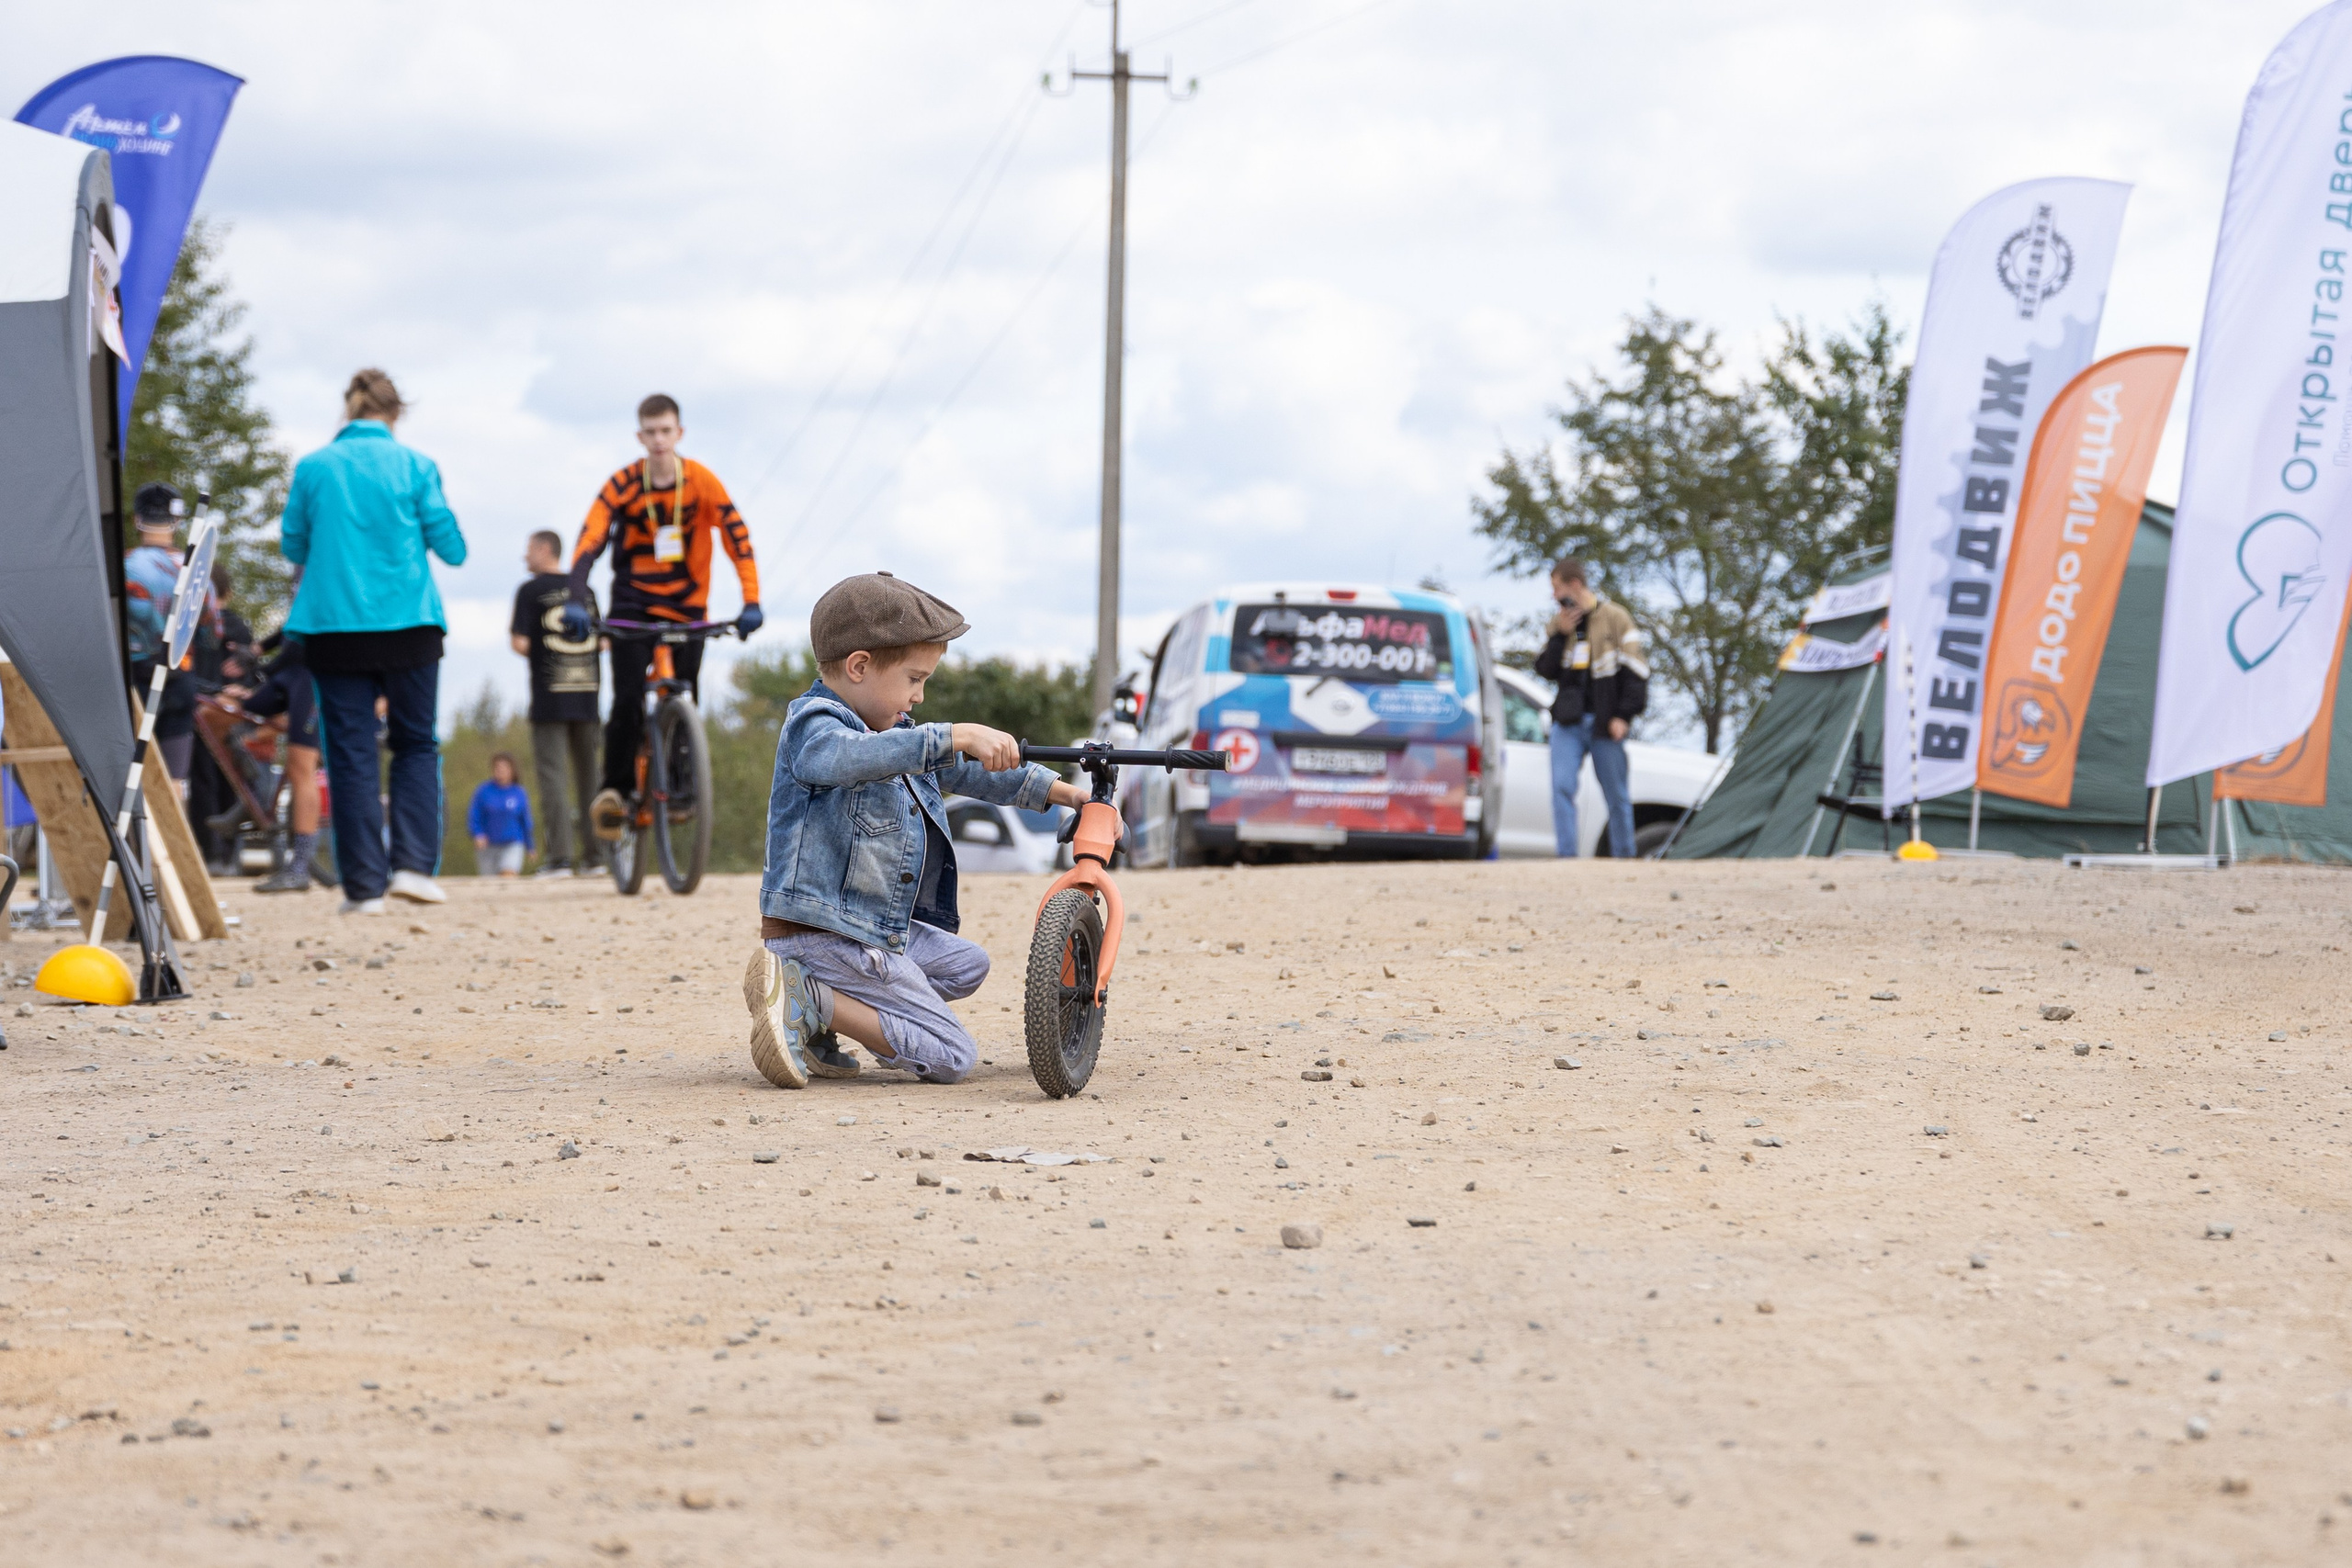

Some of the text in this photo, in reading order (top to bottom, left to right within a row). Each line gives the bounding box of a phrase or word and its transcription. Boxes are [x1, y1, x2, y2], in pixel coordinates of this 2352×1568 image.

[2280, 249, 2347, 491] Открытая
[1249, 609, 1430, 646] ьфаМед
[1921, 355, 2032, 761] ВЕЛОДВИЖ
[2031, 381, 2123, 683] ДОДО ПИЦЦА
[1292, 641, 1428, 672] 2-300-001
